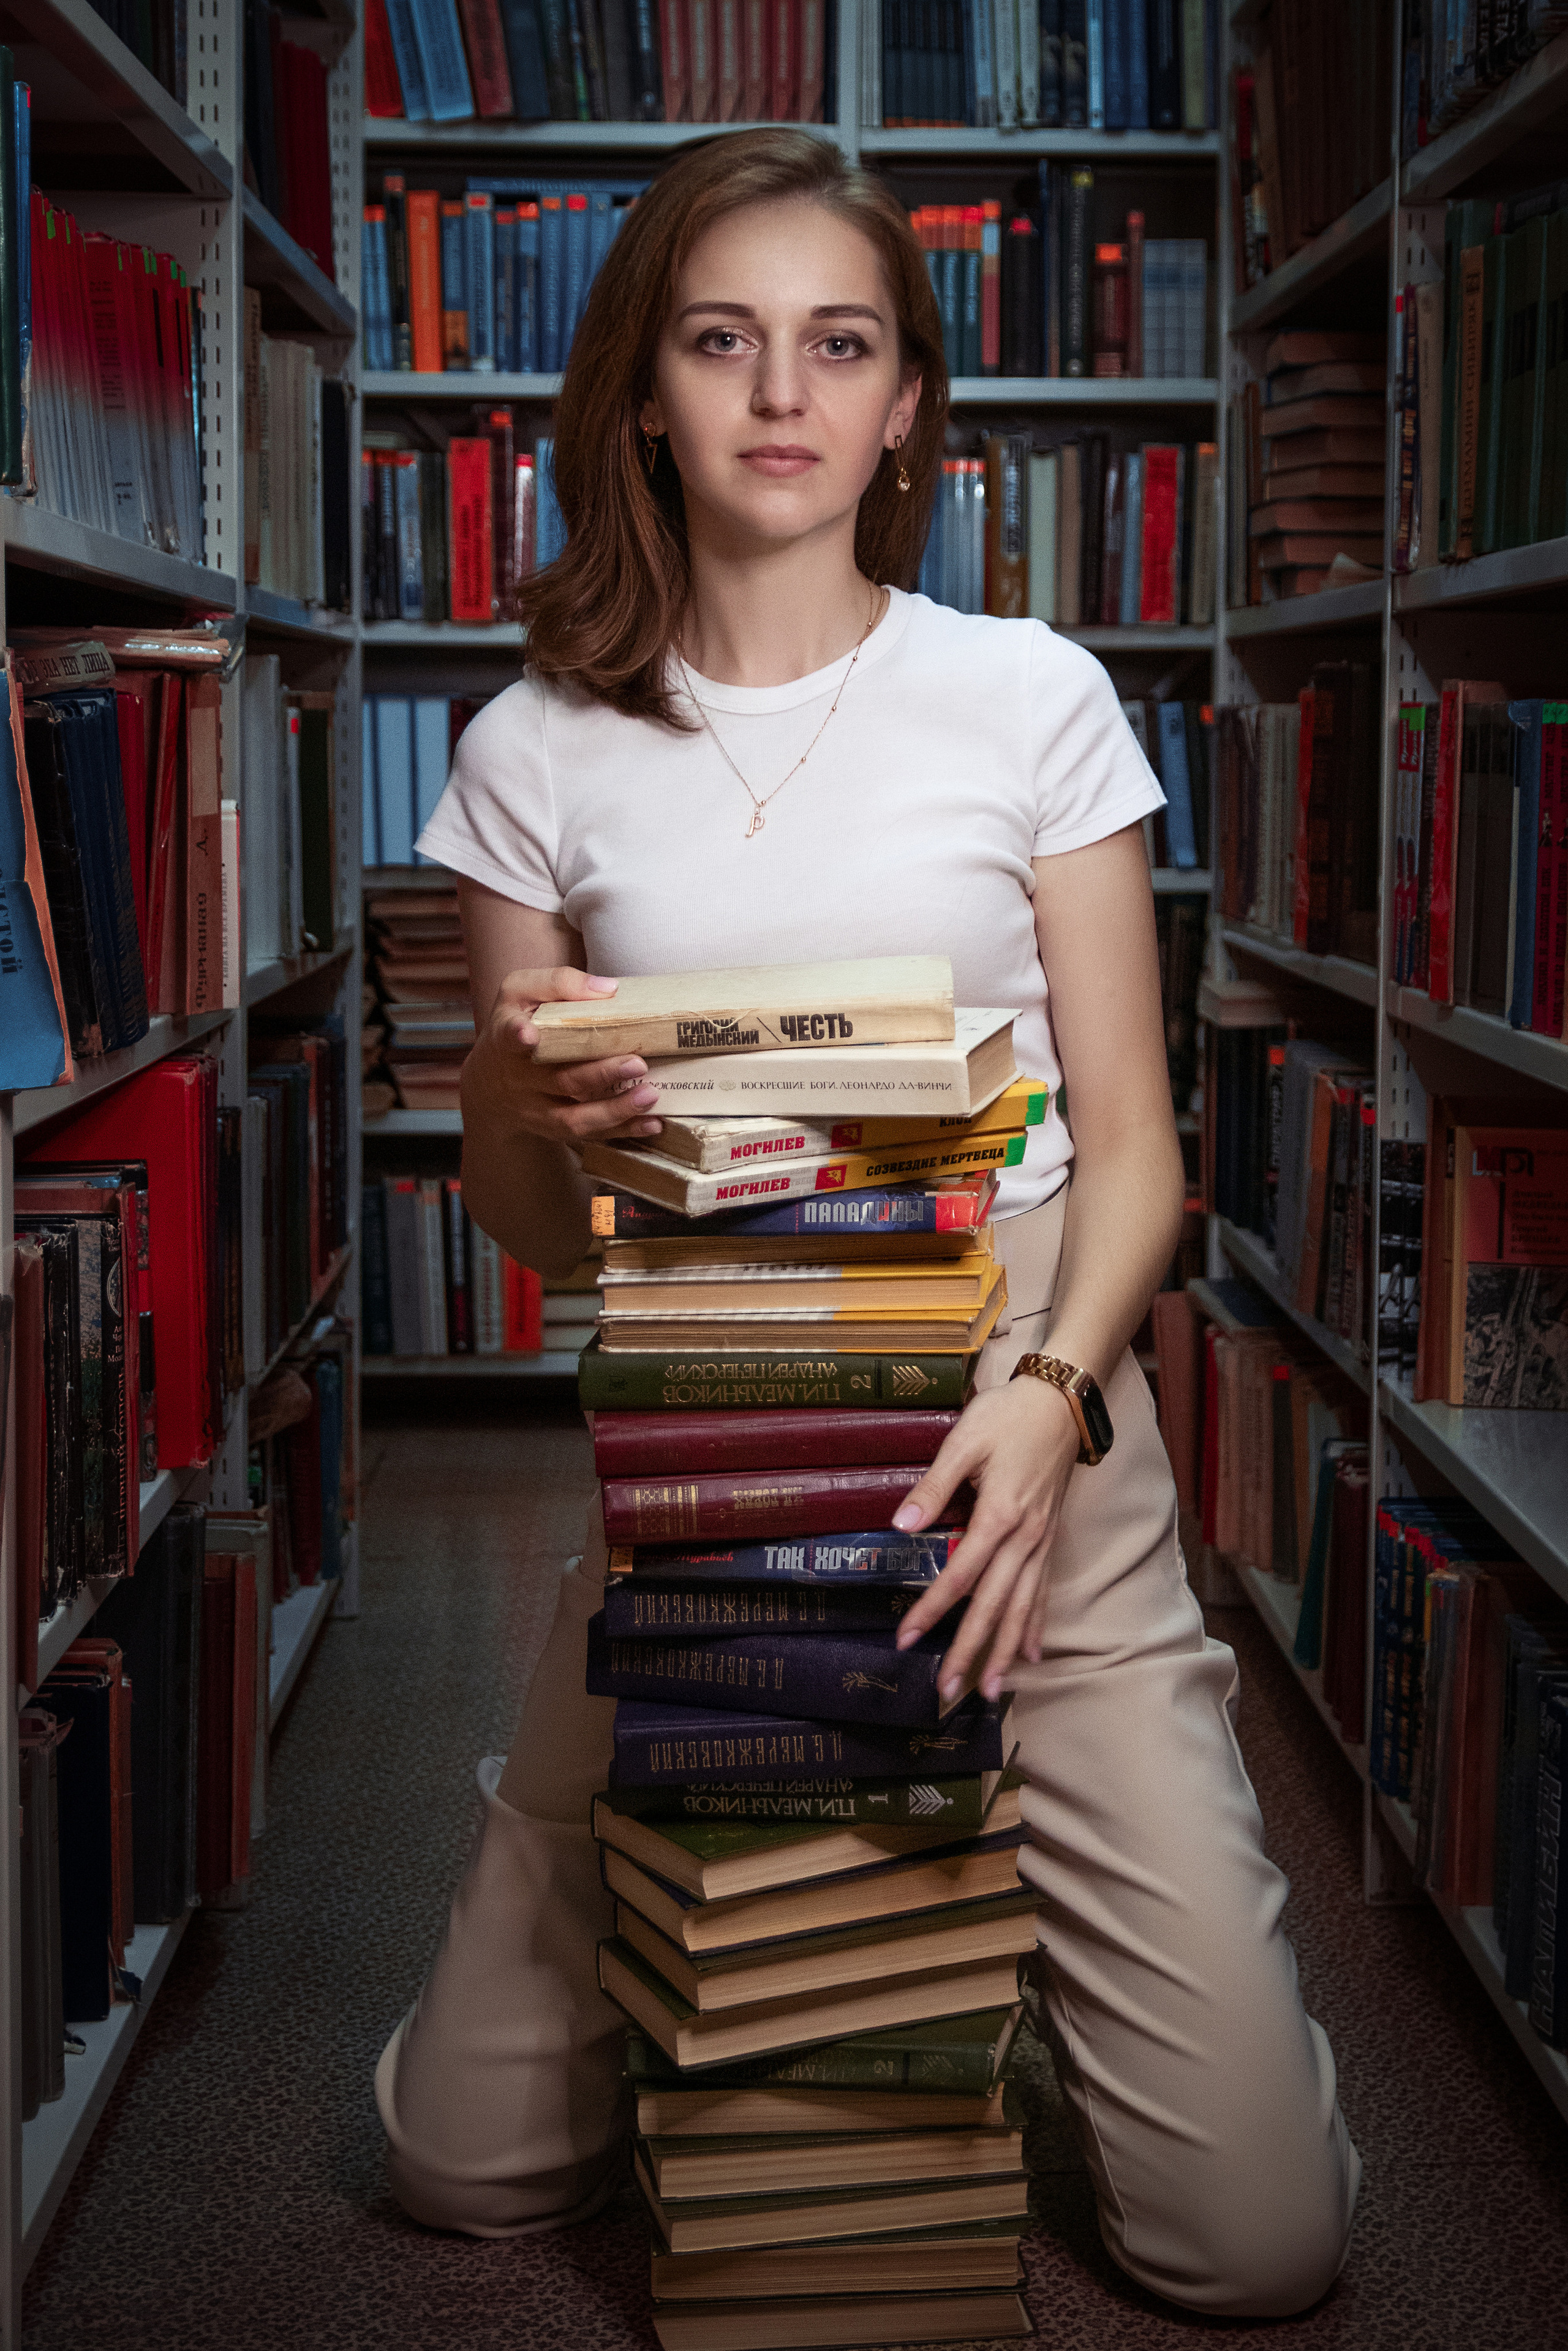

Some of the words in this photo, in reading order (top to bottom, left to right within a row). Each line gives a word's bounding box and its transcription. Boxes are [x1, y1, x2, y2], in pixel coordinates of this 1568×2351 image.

[59, 655, 81, 676] НЕТ
[81, 651, 110, 676] ЛИЦА
[676, 1017, 739, 1035] ГРИГОРИЙ
[677, 1028, 760, 1048] МЕДЫНСКИЙ
[780, 1013, 853, 1042] ЧЕСТЬ
[741, 1081, 805, 1090] ВОСКРЕСШИЕ
[810, 1081, 839, 1090] БОГИ.
[839, 1081, 895, 1090] ЛЕОНАРДО
[897, 1081, 952, 1090] ДА-ВИНЧИ
[729, 1136, 806, 1160] МОГИЛЕВ
[865, 1155, 939, 1177] СОЗВЕЗДИЕ
[940, 1146, 1005, 1167] МЕРТВЕЦА
[715, 1177, 791, 1201] МОГИЛЕВ
[804, 1201, 924, 1226] ПАЛАДИНЫ
[662, 1383, 797, 1403] МЕЛЬНИКОВ
[764, 1545, 805, 1569] ТАК
[815, 1546, 879, 1571] ХОЧЕТ
[885, 1547, 925, 1571] БОГ
[633, 1592, 789, 1627] МЕРЕЖКОВСКИЙ
[610, 1642, 750, 1686] МЕРЕЖКОВСКИЙ
[649, 1735, 805, 1774] МЕРЕЖКОВСКИЙ
[682, 1795, 812, 1816] МЕЛЬНИКОВ
